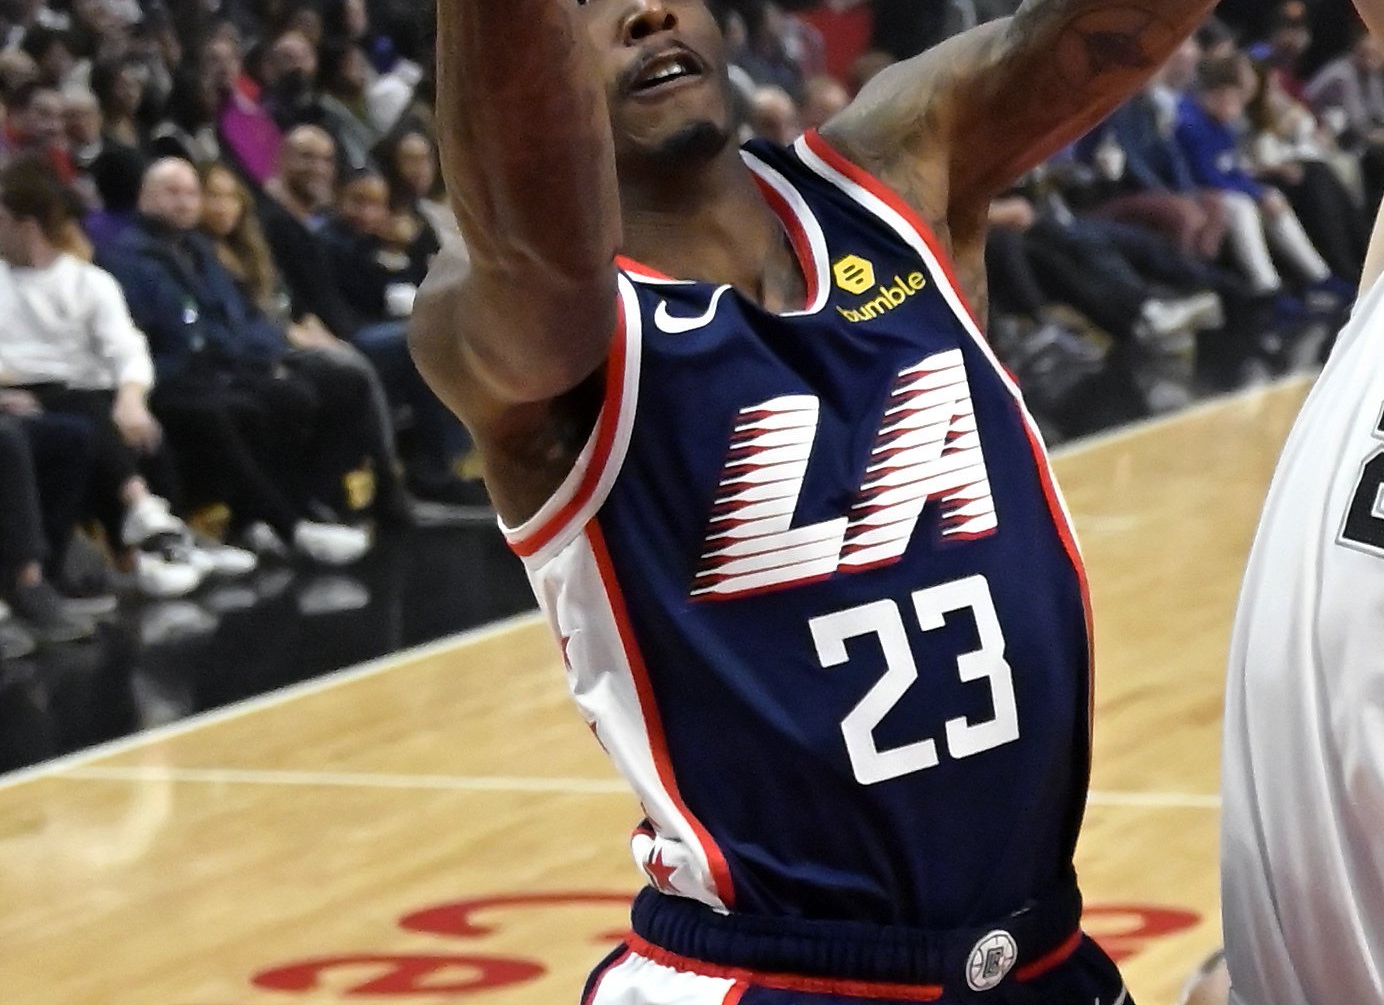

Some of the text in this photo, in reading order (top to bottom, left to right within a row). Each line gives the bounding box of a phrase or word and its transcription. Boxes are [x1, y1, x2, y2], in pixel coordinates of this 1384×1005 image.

[835, 274, 926, 323] bumble
[690, 347, 999, 603] LA
[808, 573, 1021, 786] 23
